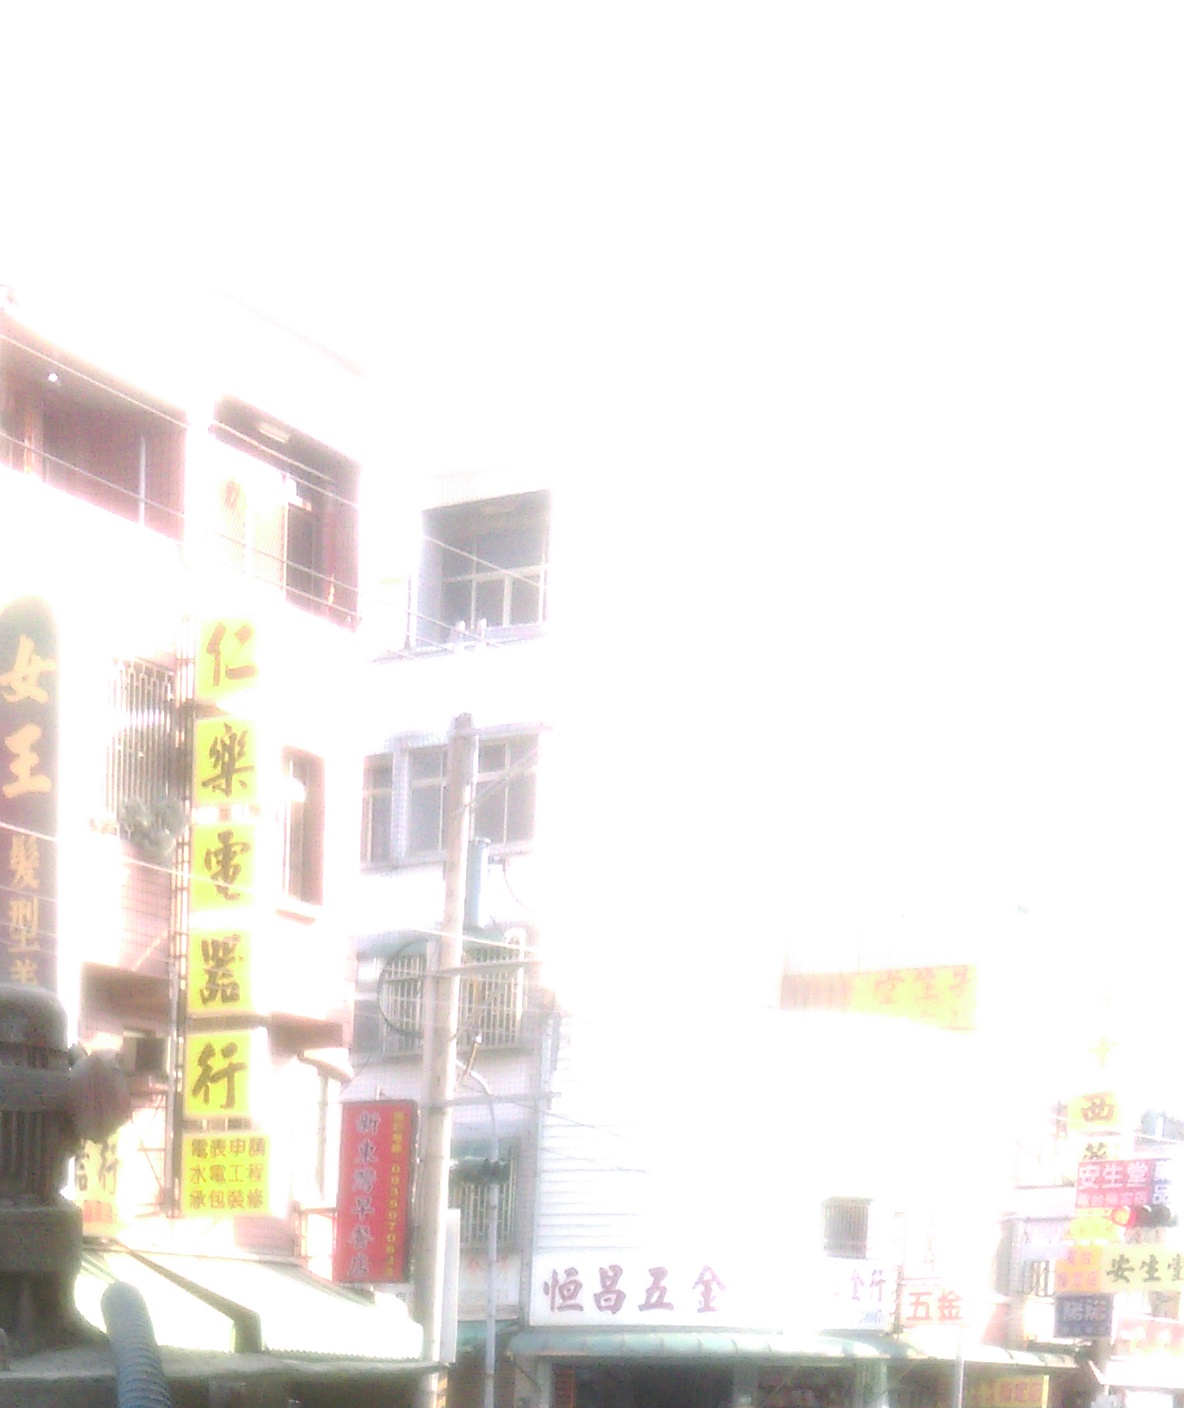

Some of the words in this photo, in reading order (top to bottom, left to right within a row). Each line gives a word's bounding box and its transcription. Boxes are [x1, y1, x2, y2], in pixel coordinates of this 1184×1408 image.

[1078, 1161, 1149, 1189] 安生堂
[906, 1290, 964, 1322] 五金
